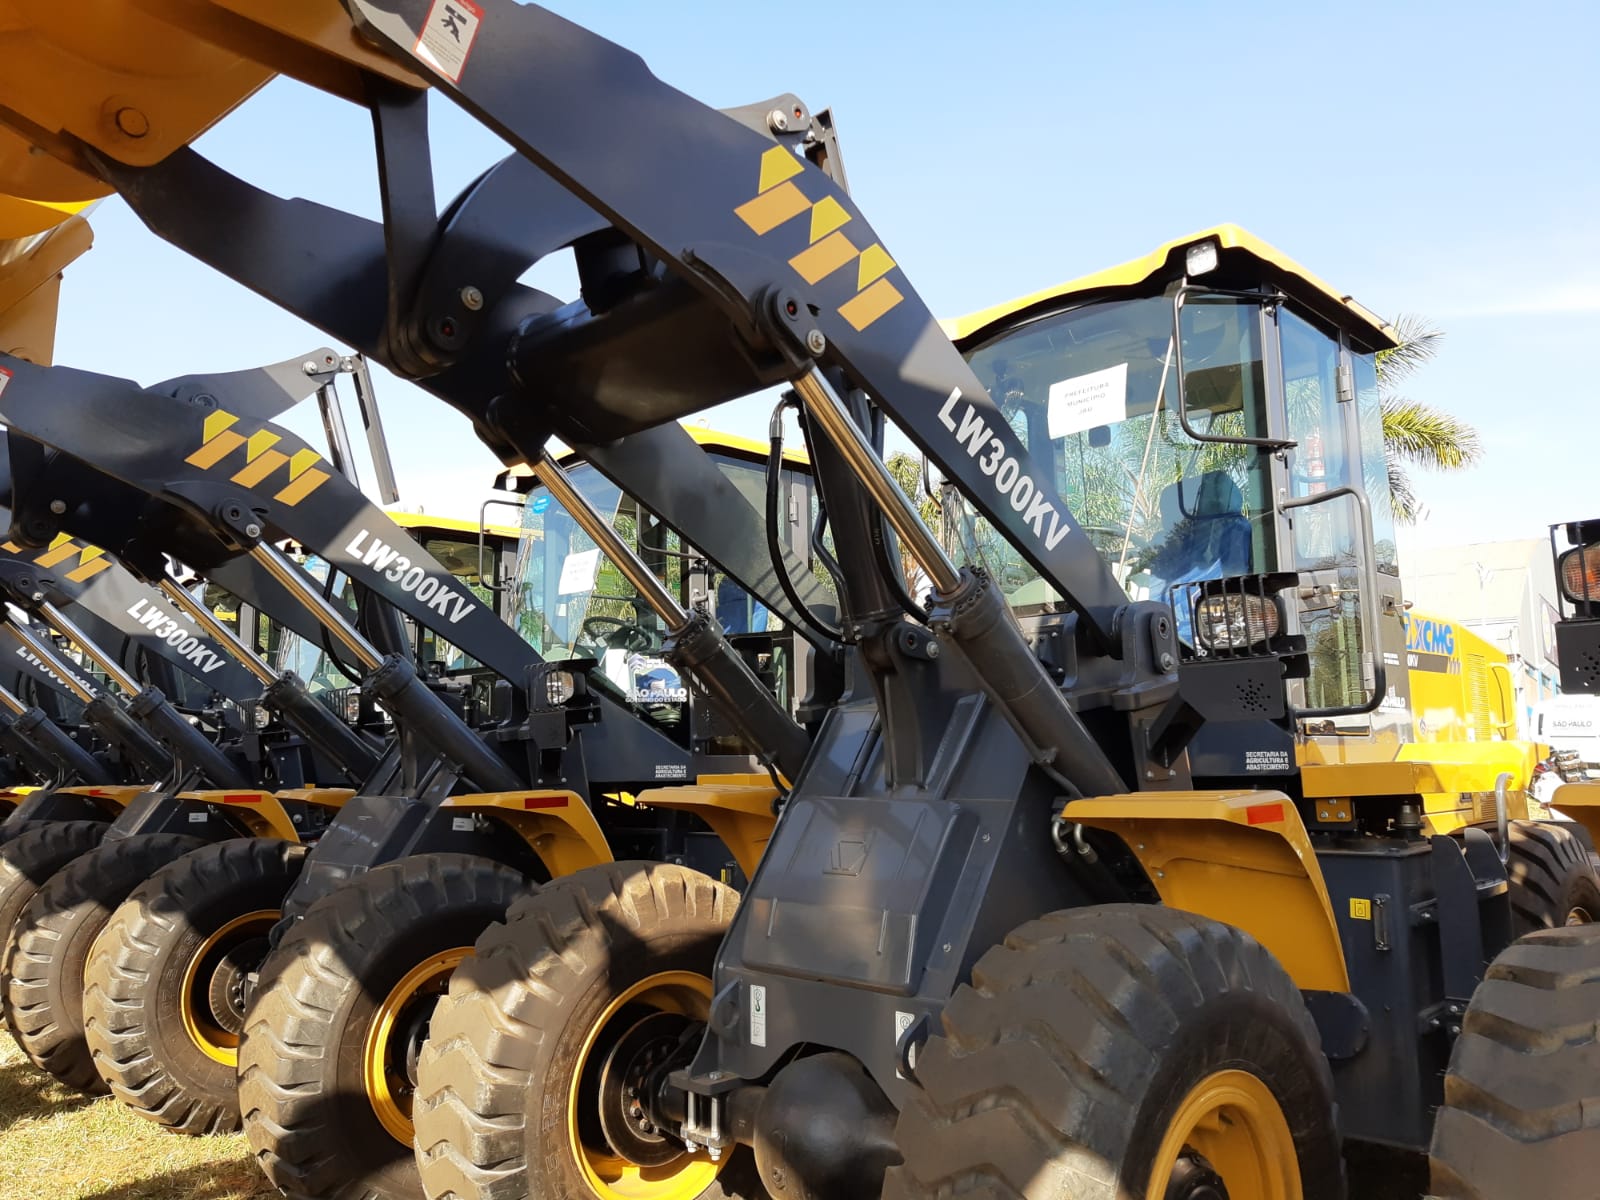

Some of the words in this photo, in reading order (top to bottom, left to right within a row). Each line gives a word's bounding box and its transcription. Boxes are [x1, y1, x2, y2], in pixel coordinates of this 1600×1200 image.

[937, 387, 1071, 551] LW300KV
[345, 529, 476, 623] LW300KV
[127, 598, 226, 673] LW300KV
[1413, 618, 1454, 655] XCMG
[650, 687, 687, 697] PAULO
